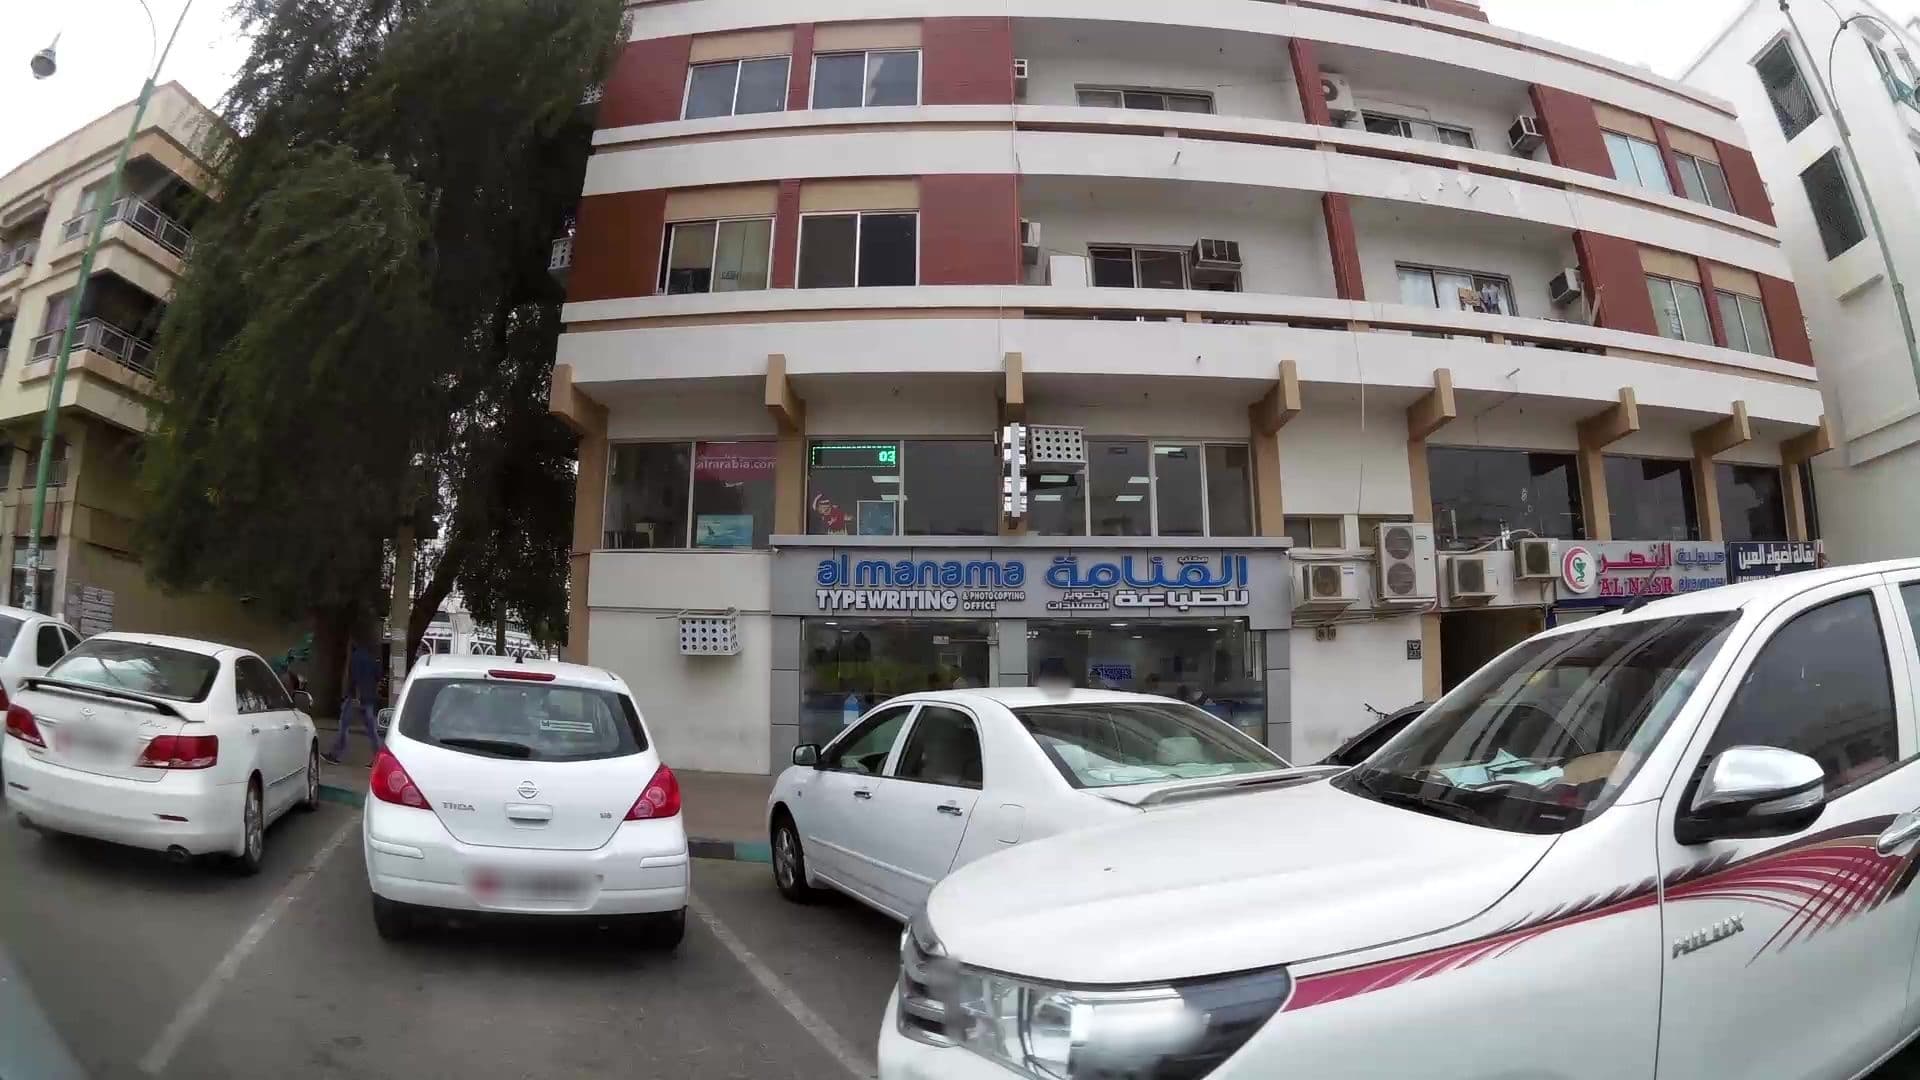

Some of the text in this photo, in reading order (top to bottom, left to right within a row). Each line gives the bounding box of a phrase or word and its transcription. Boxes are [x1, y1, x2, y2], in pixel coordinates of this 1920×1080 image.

[1600, 542, 1725, 574] صيدلية النصر
[1738, 543, 1765, 570] العين
[816, 554, 1025, 588] al manama
[962, 591, 1025, 601] & PHOTOCOPYING
[1063, 590, 1110, 601] وتصوير
[1600, 576, 1674, 596] AL NASR
[816, 589, 959, 611] TYPEWRITING
[963, 601, 997, 610] OFFICE
[1046, 600, 1110, 610] المستندات
[1113, 589, 1250, 612] للطباعة
[1672, 912, 1745, 959] HILUX
